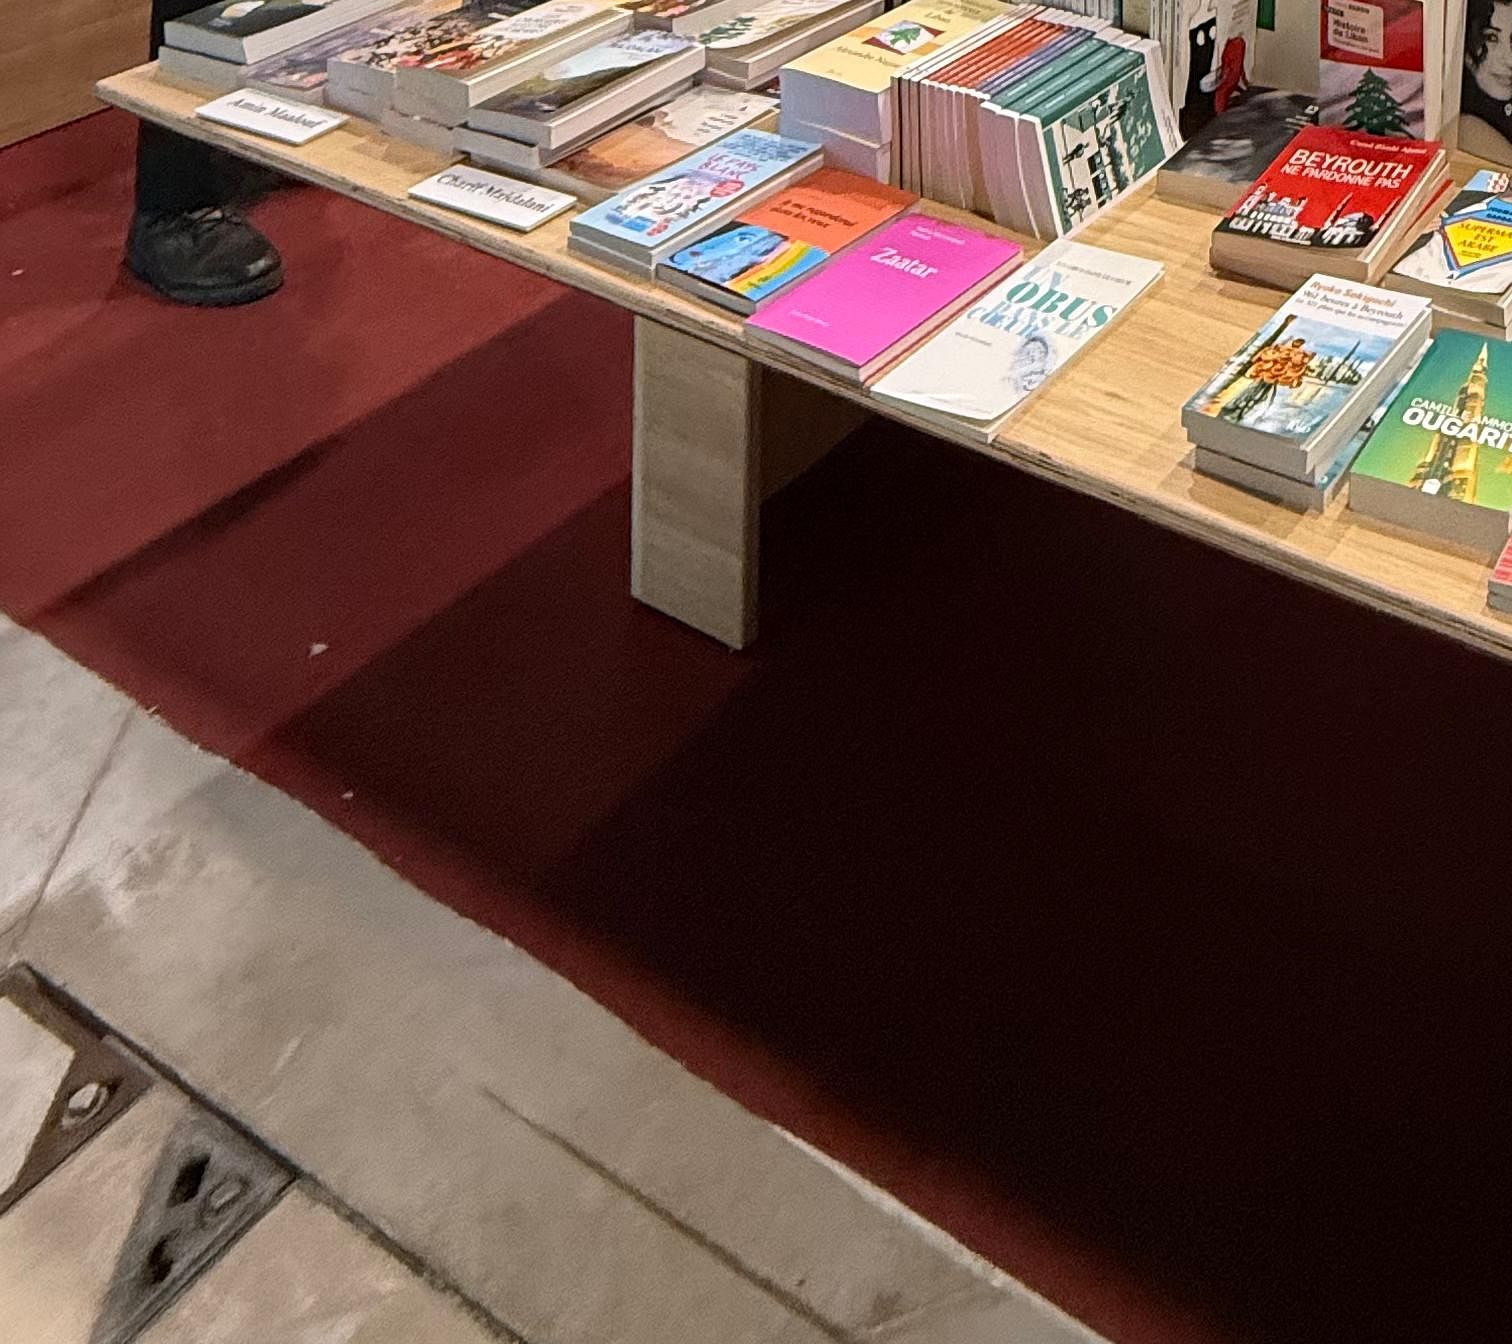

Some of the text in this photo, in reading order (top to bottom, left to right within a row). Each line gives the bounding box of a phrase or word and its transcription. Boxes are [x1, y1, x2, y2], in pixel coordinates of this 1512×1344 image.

[1281, 164, 1403, 189] NE PARDONNE PAS
[1289, 149, 1413, 179] BEYROUTH
[1458, 240, 1499, 252] ARABE
[870, 247, 938, 278] Zaatar
[1006, 281, 1117, 327] OBUS
